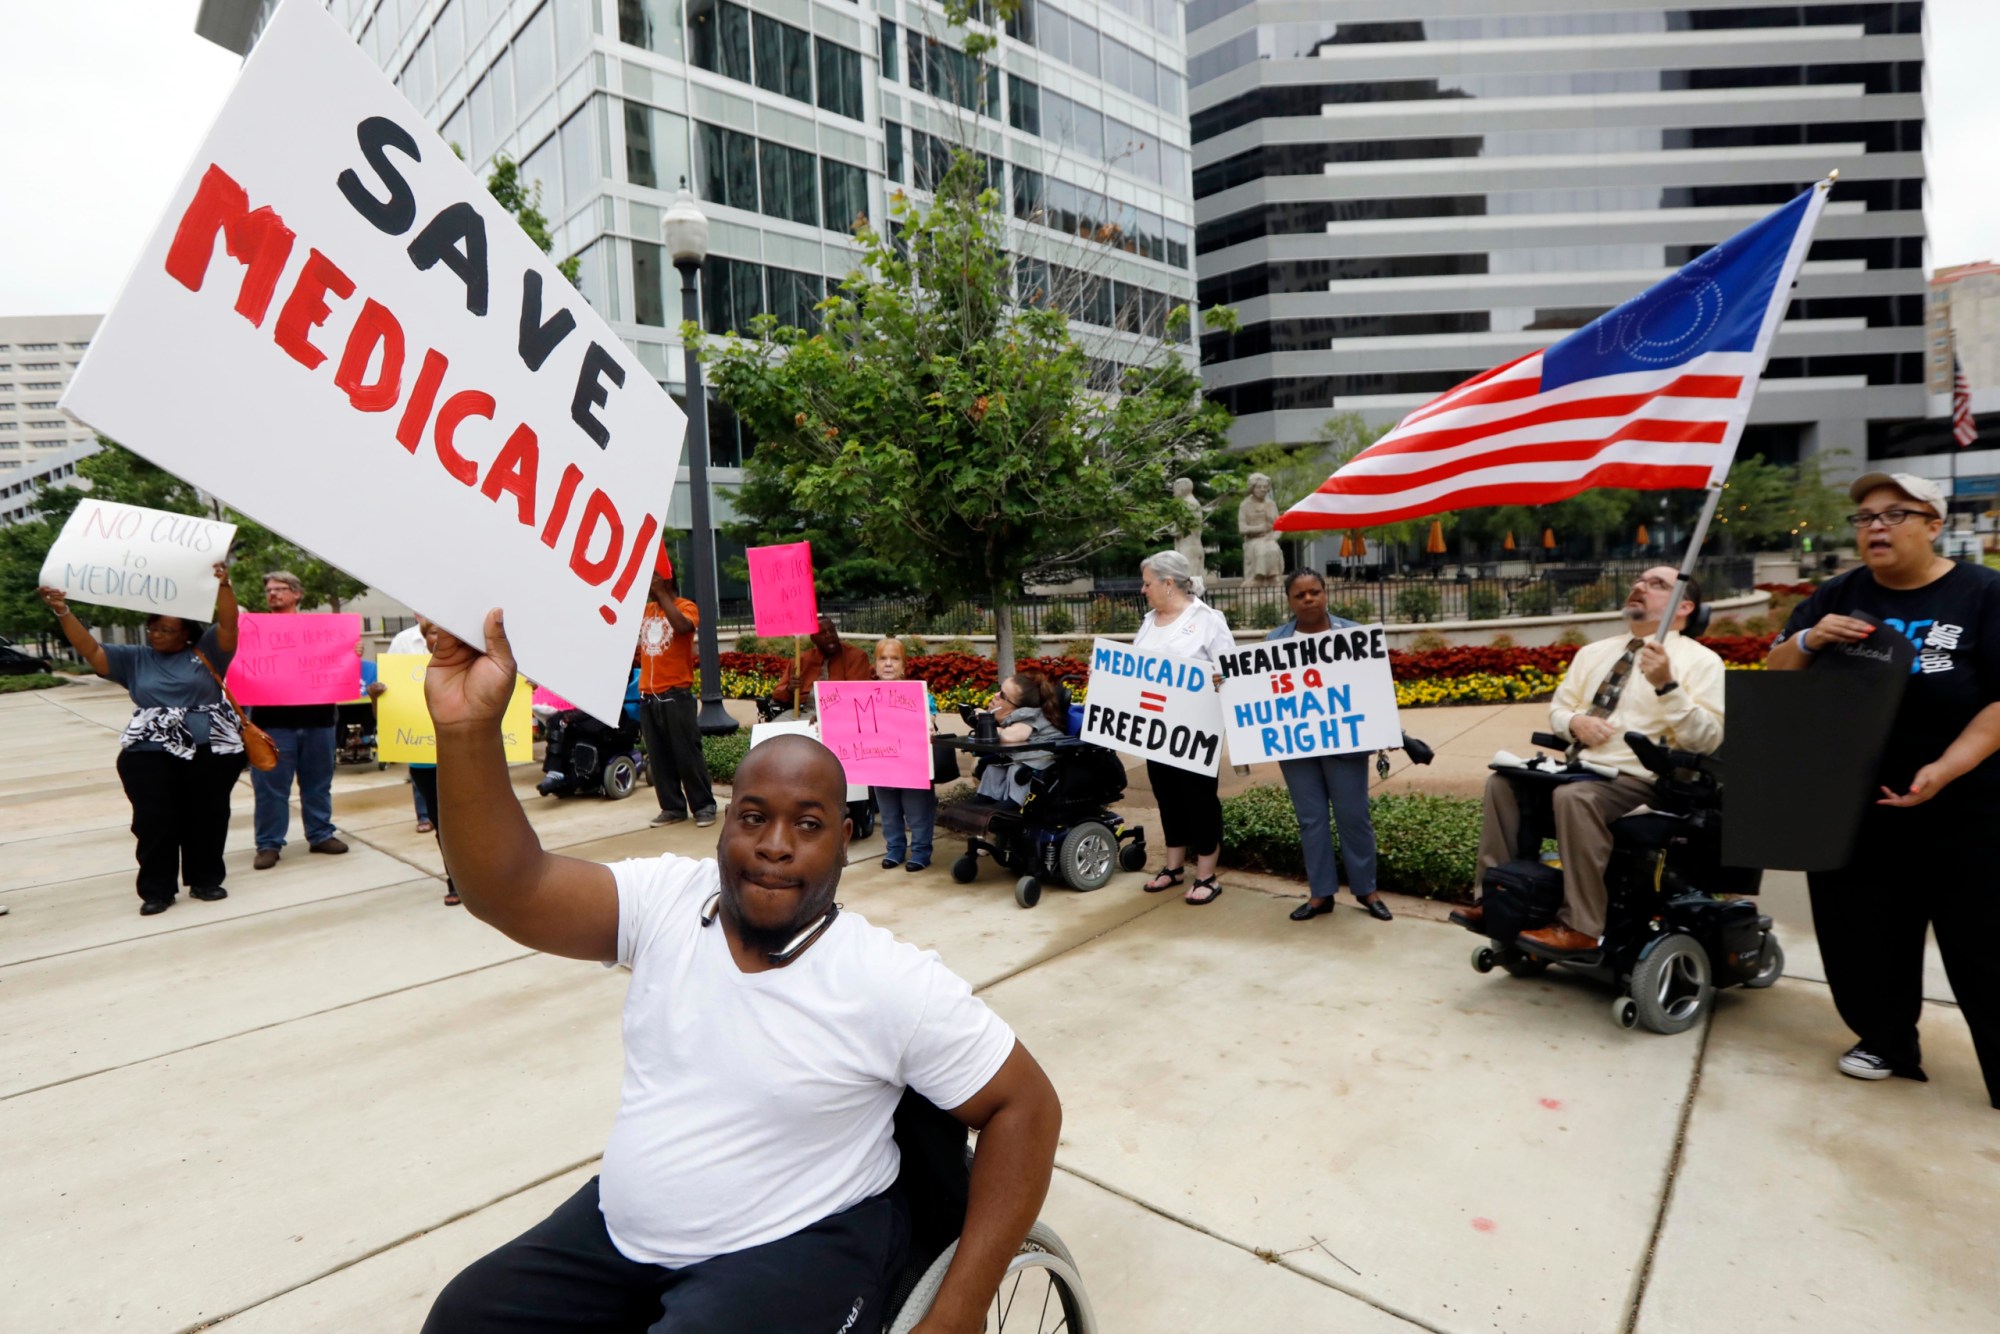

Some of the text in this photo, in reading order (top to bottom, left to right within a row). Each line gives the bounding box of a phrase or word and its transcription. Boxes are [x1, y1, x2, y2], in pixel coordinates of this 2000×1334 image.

[337, 116, 625, 450] SAVE
[165, 163, 658, 625] MEDICAID!
[84, 507, 142, 540] NO
[122, 549, 148, 569] to
[64, 562, 178, 605] MEDICAID
[269, 631, 297, 647] OUR
[1218, 628, 1387, 679] HEALTHCARE
[242, 655, 279, 680] NOT
[1094, 647, 1205, 693] MEDICAID
[1270, 668, 1323, 694] is a
[1234, 683, 1352, 728] HUMAN
[395, 728, 436, 746] Nurs
[1087, 703, 1219, 767] FREEDOM
[1261, 714, 1366, 757] RIGHT
